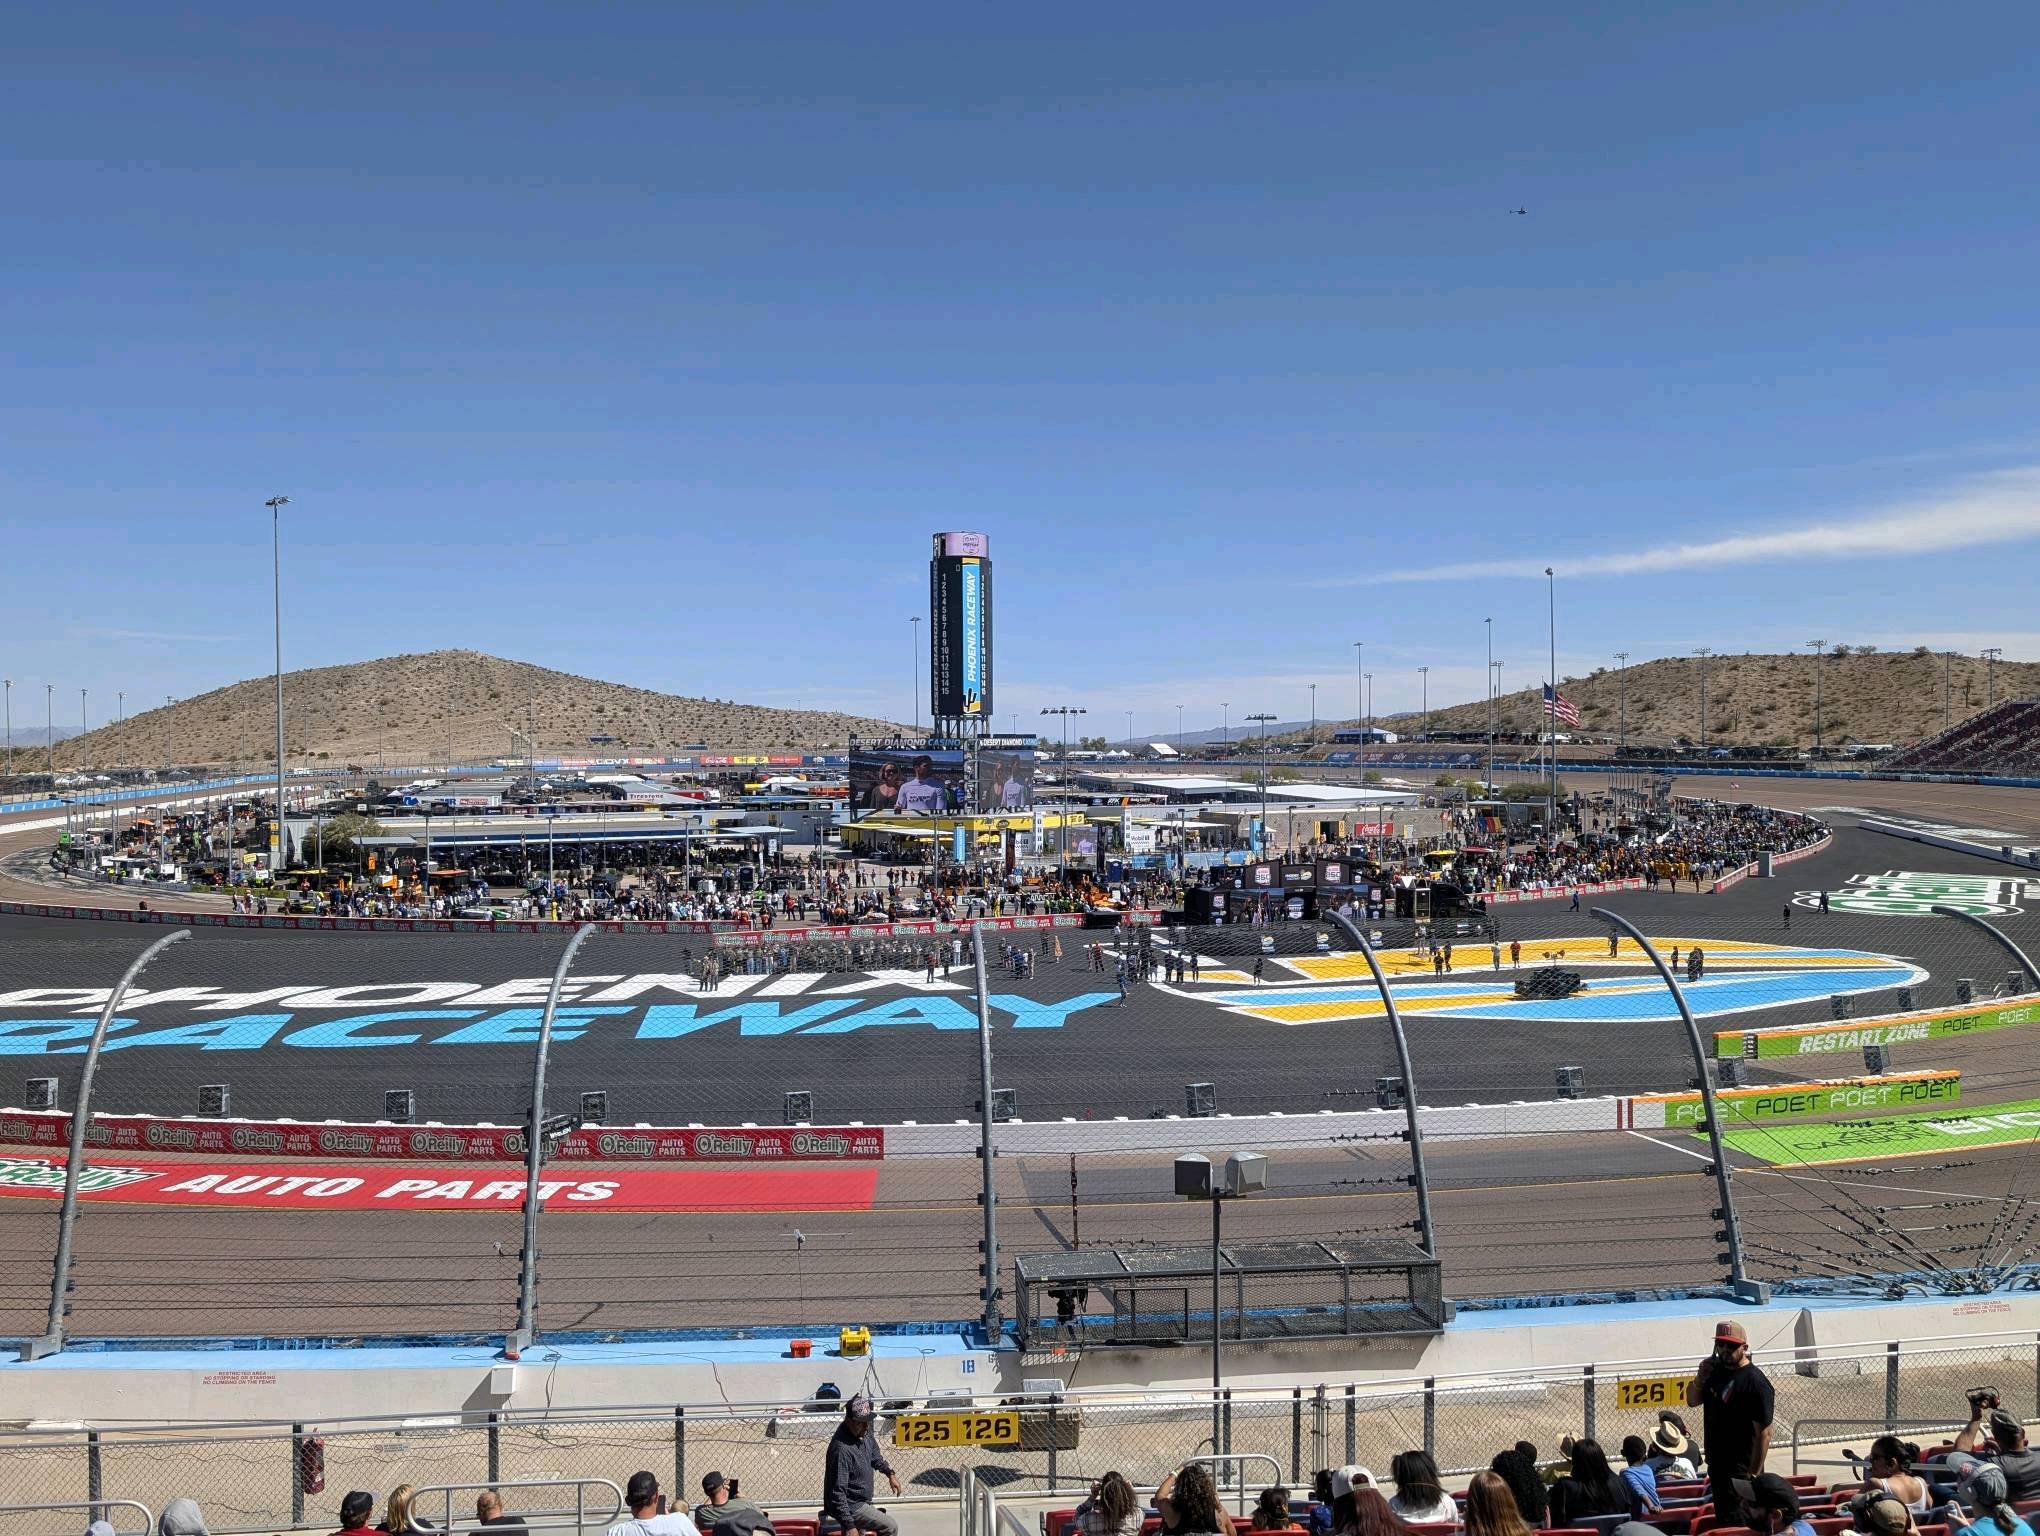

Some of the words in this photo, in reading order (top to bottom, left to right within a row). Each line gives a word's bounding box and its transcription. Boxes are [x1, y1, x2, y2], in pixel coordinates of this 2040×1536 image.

[966, 570, 976, 626] RACEWAY
[967, 628, 977, 682] PHOENIX
[850, 738, 882, 747] DESERT
[884, 738, 926, 747] DIAMOND
[927, 738, 961, 747] CASINO
[0, 964, 978, 1013] PHOENIX
[0, 992, 1123, 1055] RACEWAY
[1798, 1027, 1885, 1054] RESTART
[1884, 1021, 1931, 1043] ZONE
[1942, 1015, 1981, 1033] POET
[1997, 1007, 2032, 1024] POET
[1755, 1094, 1821, 1116] POET
[1830, 1087, 1893, 1110] POET
[1900, 1079, 1960, 1101] POET
[0, 1119, 35, 1139] Reilly
[38, 1125, 56, 1133] AUTO
[64, 1119, 115, 1144] Reilly
[118, 1128, 137, 1137] AUTO
[35, 1133, 58, 1141] PARTS
[145, 1122, 199, 1148] O'Reilly
[202, 1131, 222, 1139] AUTO
[231, 1127, 286, 1152] O'Reilly
[289, 1134, 310, 1143] AUTO
[115, 1136, 139, 1145] PARTS
[200, 1138, 224, 1148] PARTS
[319, 1128, 376, 1154] O'Reilly
[379, 1136, 400, 1145] AUTO
[410, 1131, 468, 1157] O'Reilly
[472, 1138, 493, 1146] AUTO
[566, 1139, 588, 1148] AUTO
[598, 1133, 657, 1157] O'Reilly
[661, 1139, 684, 1147] AUTO
[694, 1133, 754, 1157] O'Reilly
[758, 1138, 781, 1147] AUTO
[790, 1133, 852, 1157] O'Reilly
[855, 1137, 878, 1146] AUTO
[287, 1142, 312, 1151] PARTS
[376, 1144, 402, 1153] PARTS
[469, 1147, 495, 1155] PARTS
[755, 1147, 784, 1155] PARTS
[852, 1145, 880, 1154] PARTS
[563, 1147, 590, 1156] PARTS
[659, 1147, 686, 1156] PARTS
[160, 1174, 366, 1198] AUTO
[373, 1178, 621, 1202] PARTS
[1621, 1383, 1665, 1405] 126
[901, 1420, 950, 1442] 125
[962, 1418, 1011, 1440] 126
